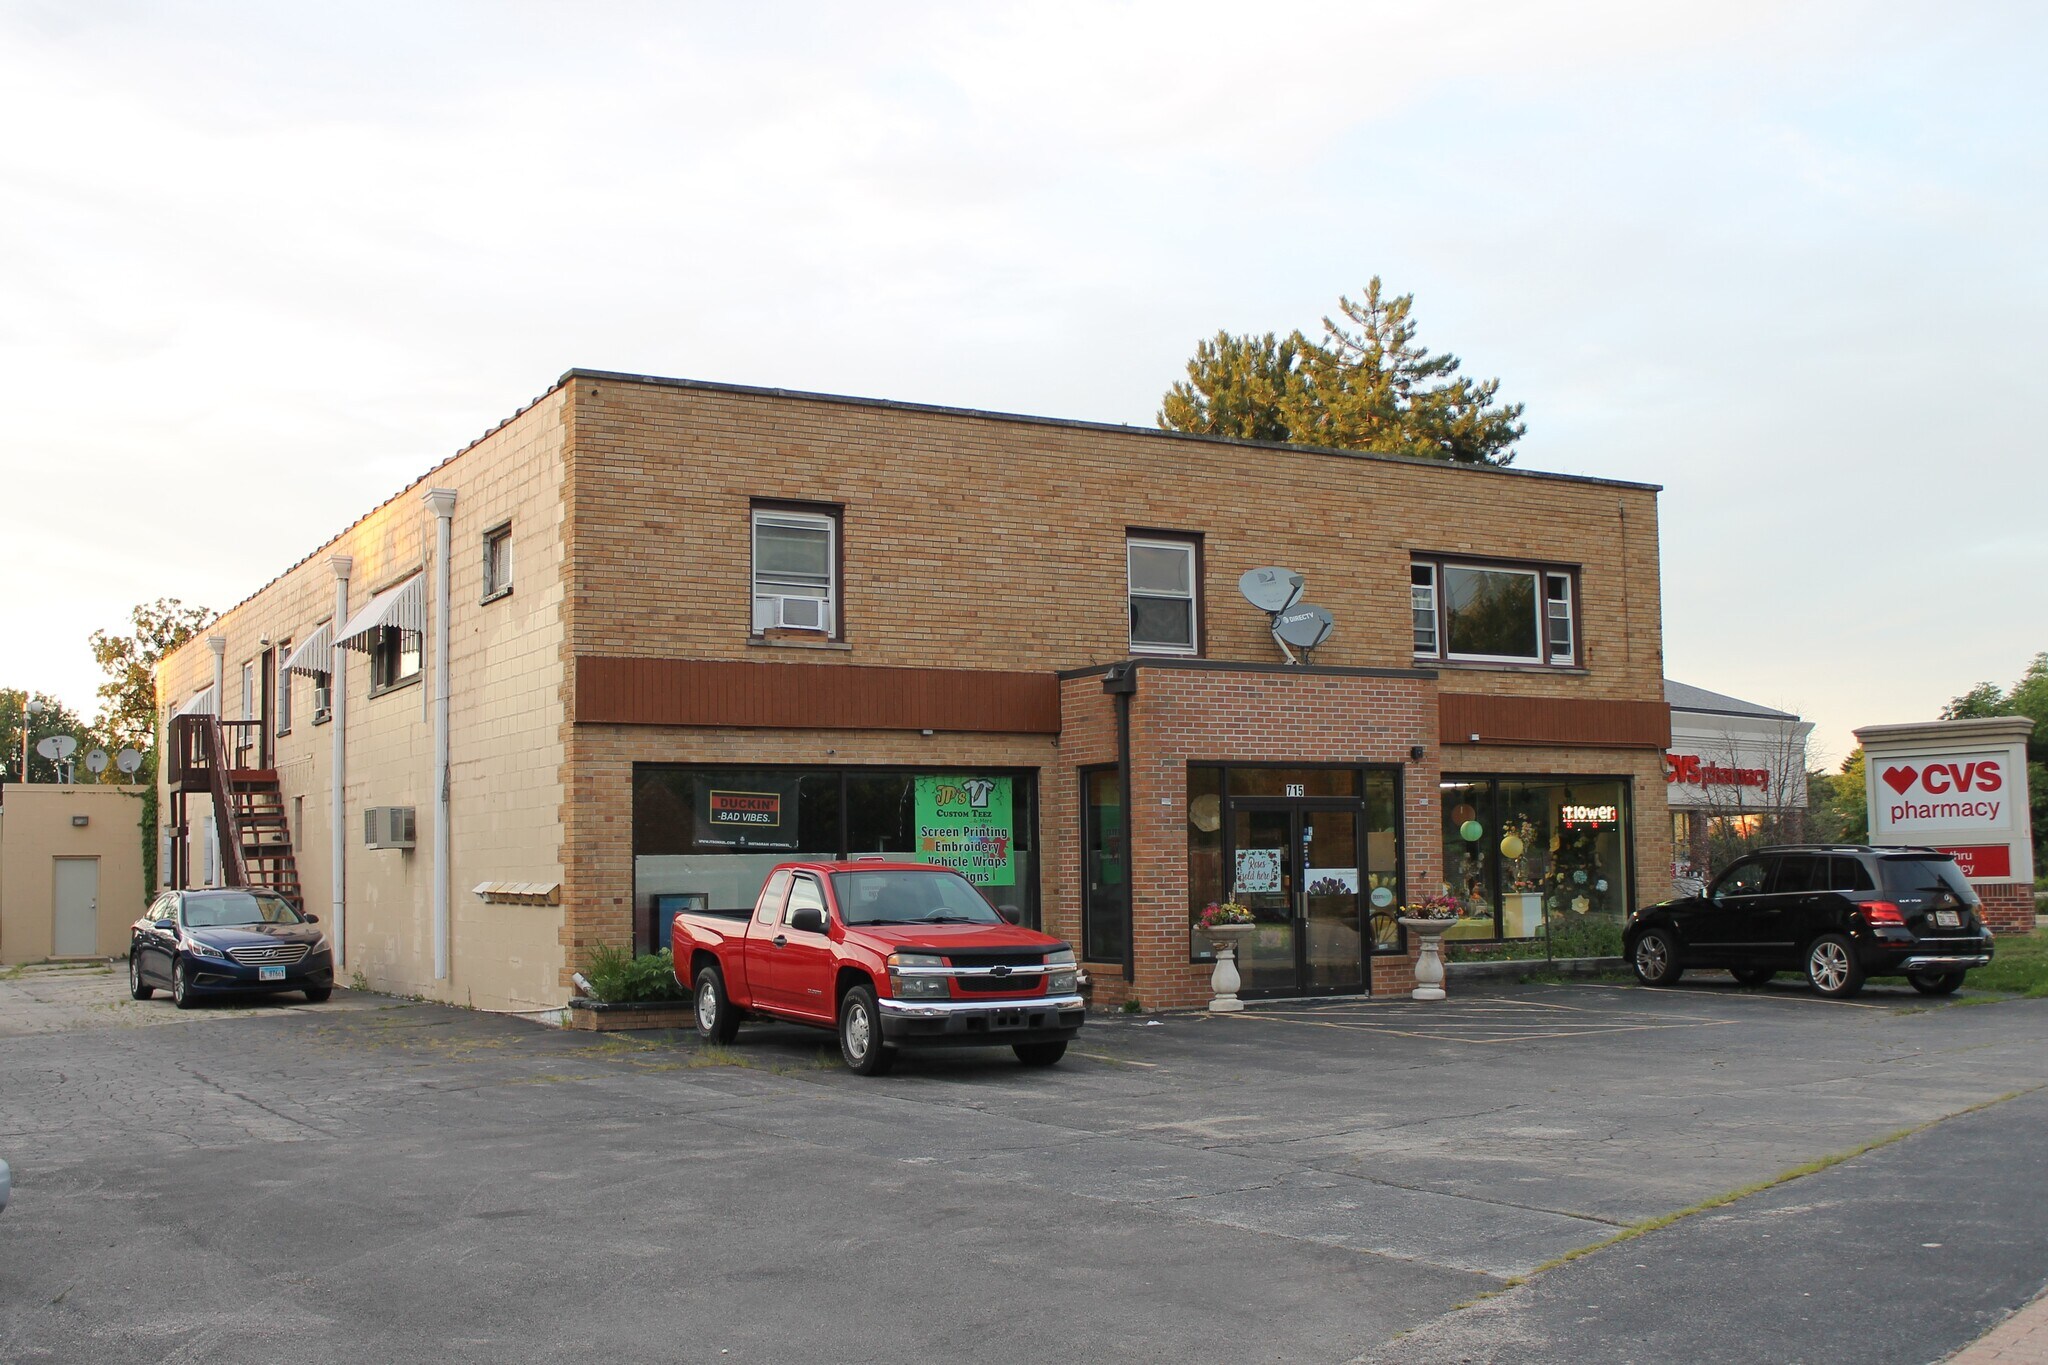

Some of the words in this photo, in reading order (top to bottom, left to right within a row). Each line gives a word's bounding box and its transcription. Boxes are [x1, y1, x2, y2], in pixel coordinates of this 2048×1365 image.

[1289, 612, 1314, 622] DIRECTV
[1921, 761, 2002, 794] CVS
[1287, 785, 1303, 796] 715
[720, 798, 774, 810] DUCKIN'
[742, 813, 771, 823] VIBES.
[1891, 801, 2000, 824] pharmacy
[921, 826, 959, 837] Screen
[963, 826, 1007, 839] Printing
[935, 841, 999, 854] Embroidery
[928, 856, 968, 867] Vehicle
[972, 857, 1008, 869] Wraps
[1248, 856, 1266, 870] Roses
